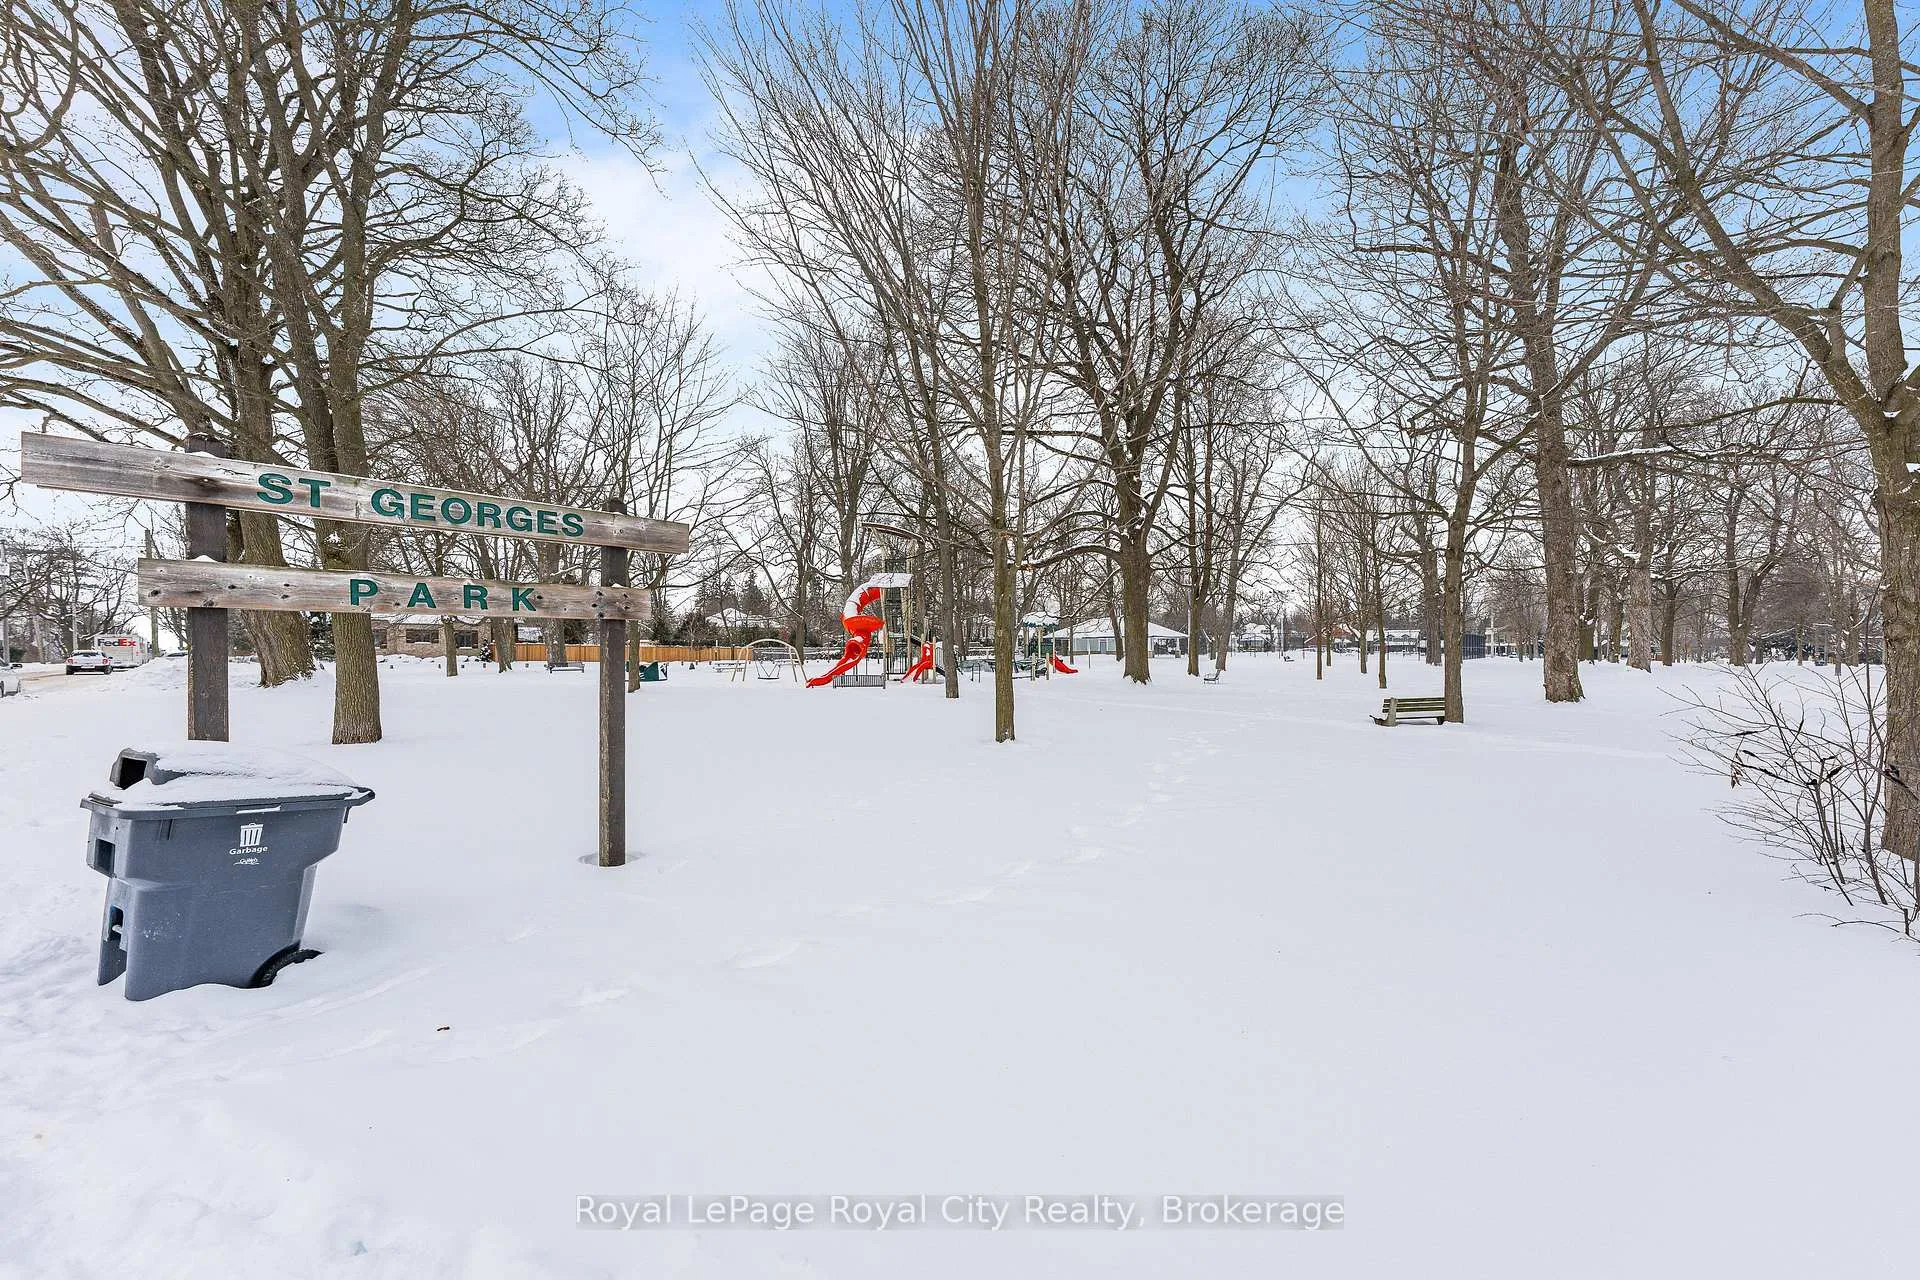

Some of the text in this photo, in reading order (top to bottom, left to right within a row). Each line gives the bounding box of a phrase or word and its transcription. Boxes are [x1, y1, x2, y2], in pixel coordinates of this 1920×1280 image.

[257, 473, 584, 537] ST GEORGES
[350, 578, 536, 611] PARK
[97, 638, 136, 647] FedEx
[229, 846, 268, 855] Garbage
